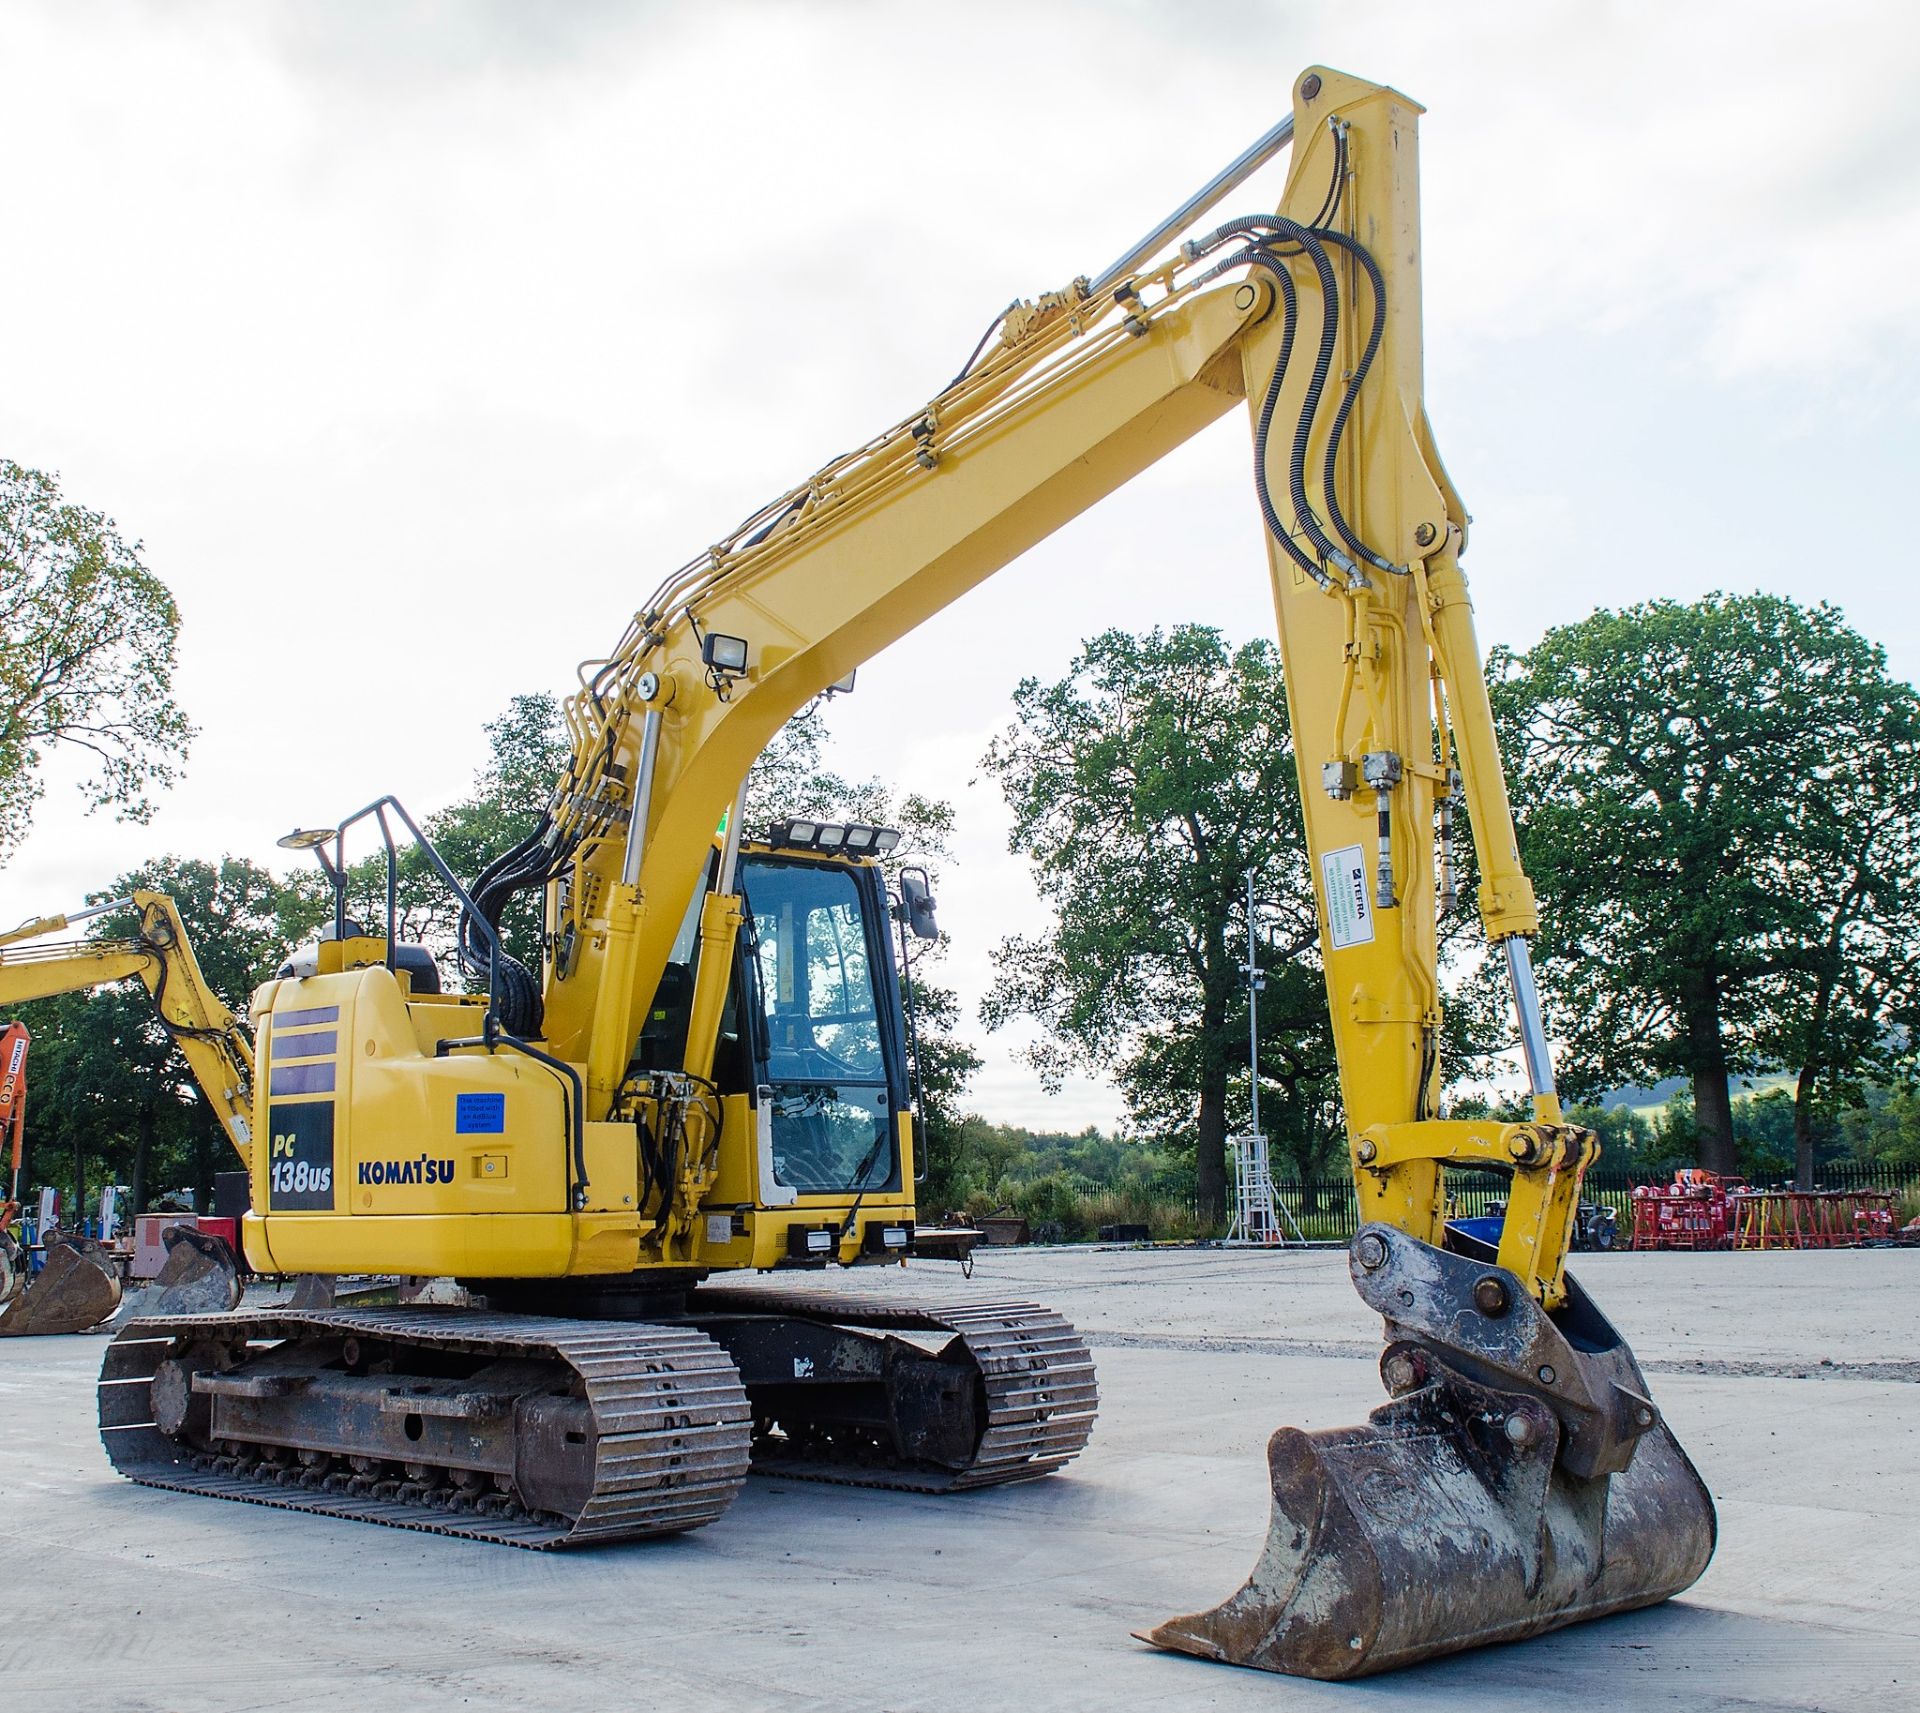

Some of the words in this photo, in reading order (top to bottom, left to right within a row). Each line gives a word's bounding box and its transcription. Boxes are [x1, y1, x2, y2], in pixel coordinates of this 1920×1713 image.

[1353, 880, 1365, 919] TEFRA
[11, 1041, 23, 1072] HITACHI
[273, 1134, 296, 1158] PC
[358, 1153, 455, 1185] KOMATSU
